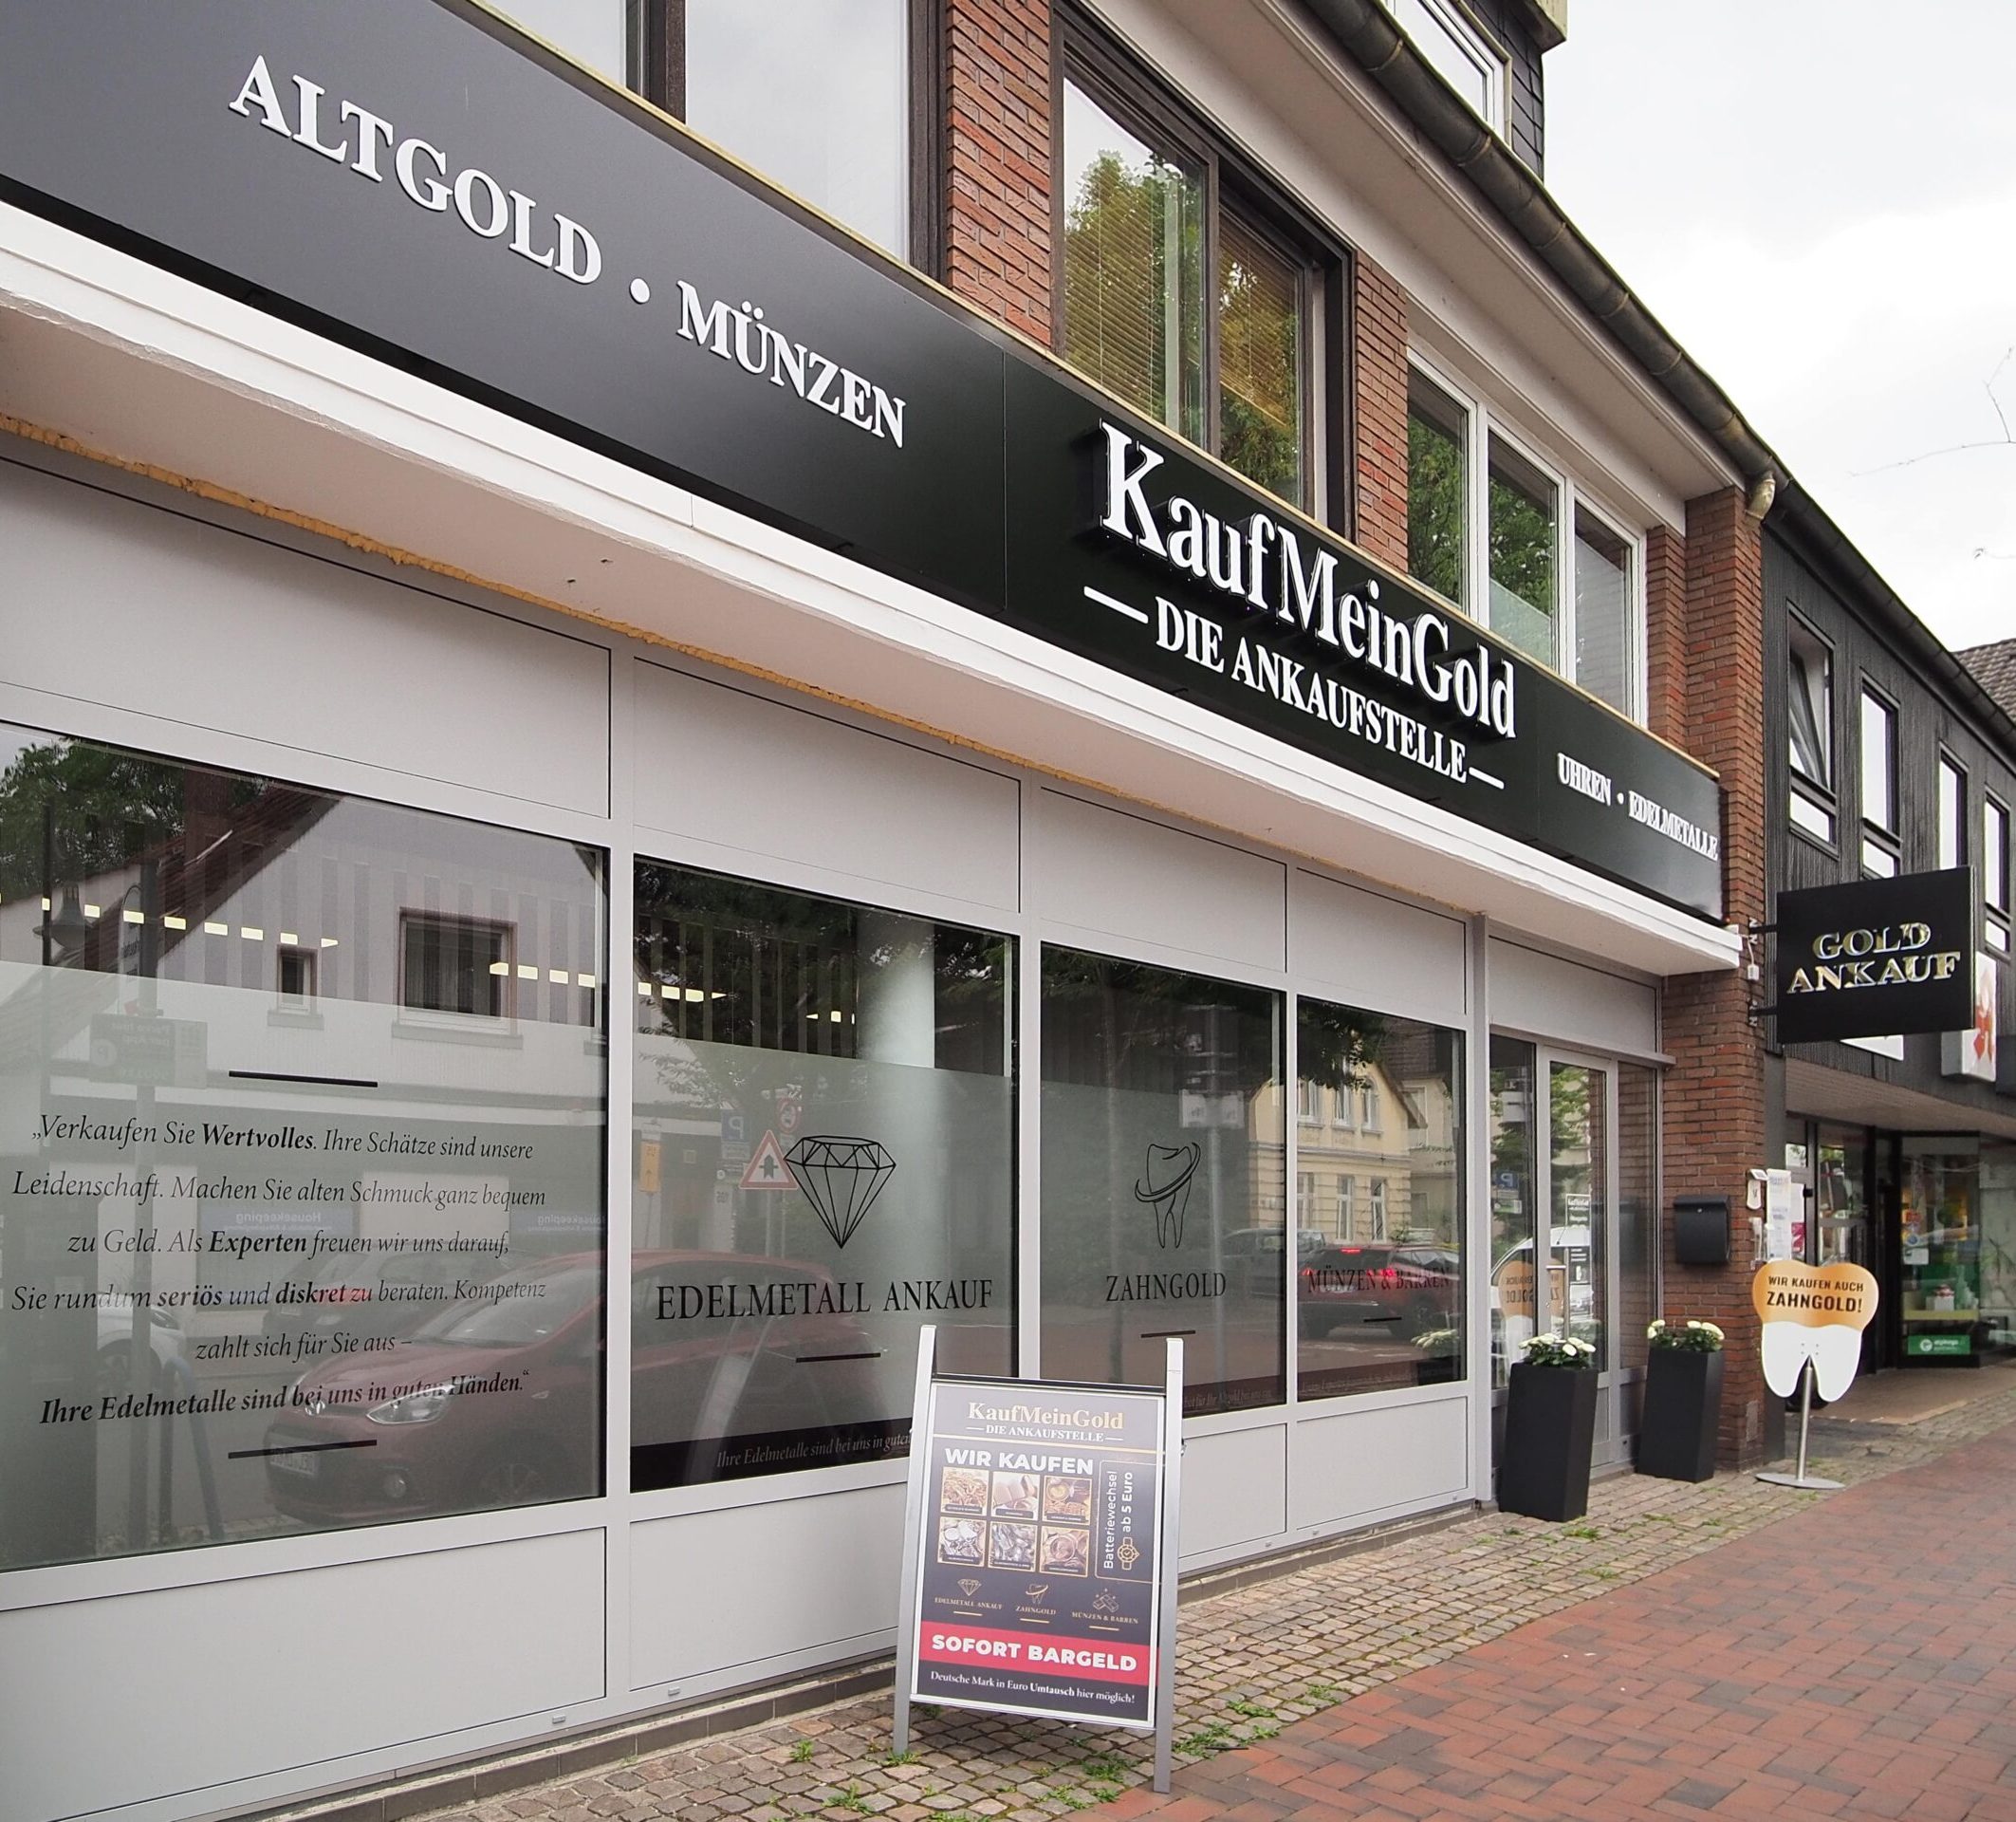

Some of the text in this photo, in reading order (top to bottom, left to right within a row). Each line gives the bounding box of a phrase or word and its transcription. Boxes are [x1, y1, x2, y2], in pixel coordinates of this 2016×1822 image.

[229, 55, 907, 449] ALTGOLD MÜNZEN
[1100, 418, 1516, 738] KaufMeinGold
[1156, 596, 1467, 783] DIE ANKAUFSTELLE
[1557, 753, 1718, 862] UHREN EDELMETALLE
[1813, 922, 1931, 959] GOLD
[1787, 951, 1961, 995] ANKAUF
[32, 1114, 533, 1159] „Verkaufen Sie Wertvolles. Ihre Schätze sind unsere
[12, 1170, 546, 1212] Leidenschaft. Machen Sie alten Schmuck ganz bequem
[67, 1229, 509, 1260] zu Geld. Als Experten freuen wir uns darauf,
[12, 1279, 546, 1310] Sie rundum seriös und diskret zu beraten. Kompetenz
[1106, 1272, 1227, 1302] ZAHNGOLD
[1308, 1265, 1376, 1293] MÜNZEN
[1768, 1276, 1863, 1292] WIR KAUFEN AUCH
[656, 1278, 993, 1321] EDELMETALL ANKAUF
[1766, 1292, 1862, 1312] ZAHNGOLD!
[195, 1334, 250, 1359] zahlt
[253, 1332, 290, 1357] sich
[292, 1334, 327, 1363] für
[331, 1331, 359, 1354] Sie
[363, 1338, 395, 1352] aus
[40, 1399, 93, 1423] Ihre
[98, 1389, 236, 1420] Edelmetalle
[241, 1385, 287, 1410] sind
[292, 1385, 321, 1407] bei
[327, 1388, 362, 1404] uns
[368, 1382, 387, 1403] in
[969, 1402, 1124, 1430] KaufMeinGold
[986, 1425, 1104, 1442] DIE ANKAUFSTELLE
[716, 1451, 742, 1468] Ihre
[744, 1444, 808, 1465] Edelmetalle
[810, 1438, 834, 1457] sind
[836, 1437, 851, 1452] bei
[853, 1440, 871, 1451] uns
[873, 1435, 883, 1449] in
[945, 1448, 1094, 1475] WIR KAUFEN
[1120, 1472, 1133, 1533] ab 5 Euro
[1103, 1471, 1118, 1569] Batteriewechsel
[1015, 1606, 1057, 1615] ZAHNGOLD
[1071, 1610, 1102, 1622] MÜNZEN
[1110, 1616, 1139, 1625] BARREN
[932, 1634, 1137, 1672] SOFORT BARGELD
[931, 1671, 1136, 1704] Deutsche Mark in Euro Umtausch hier möglich!
